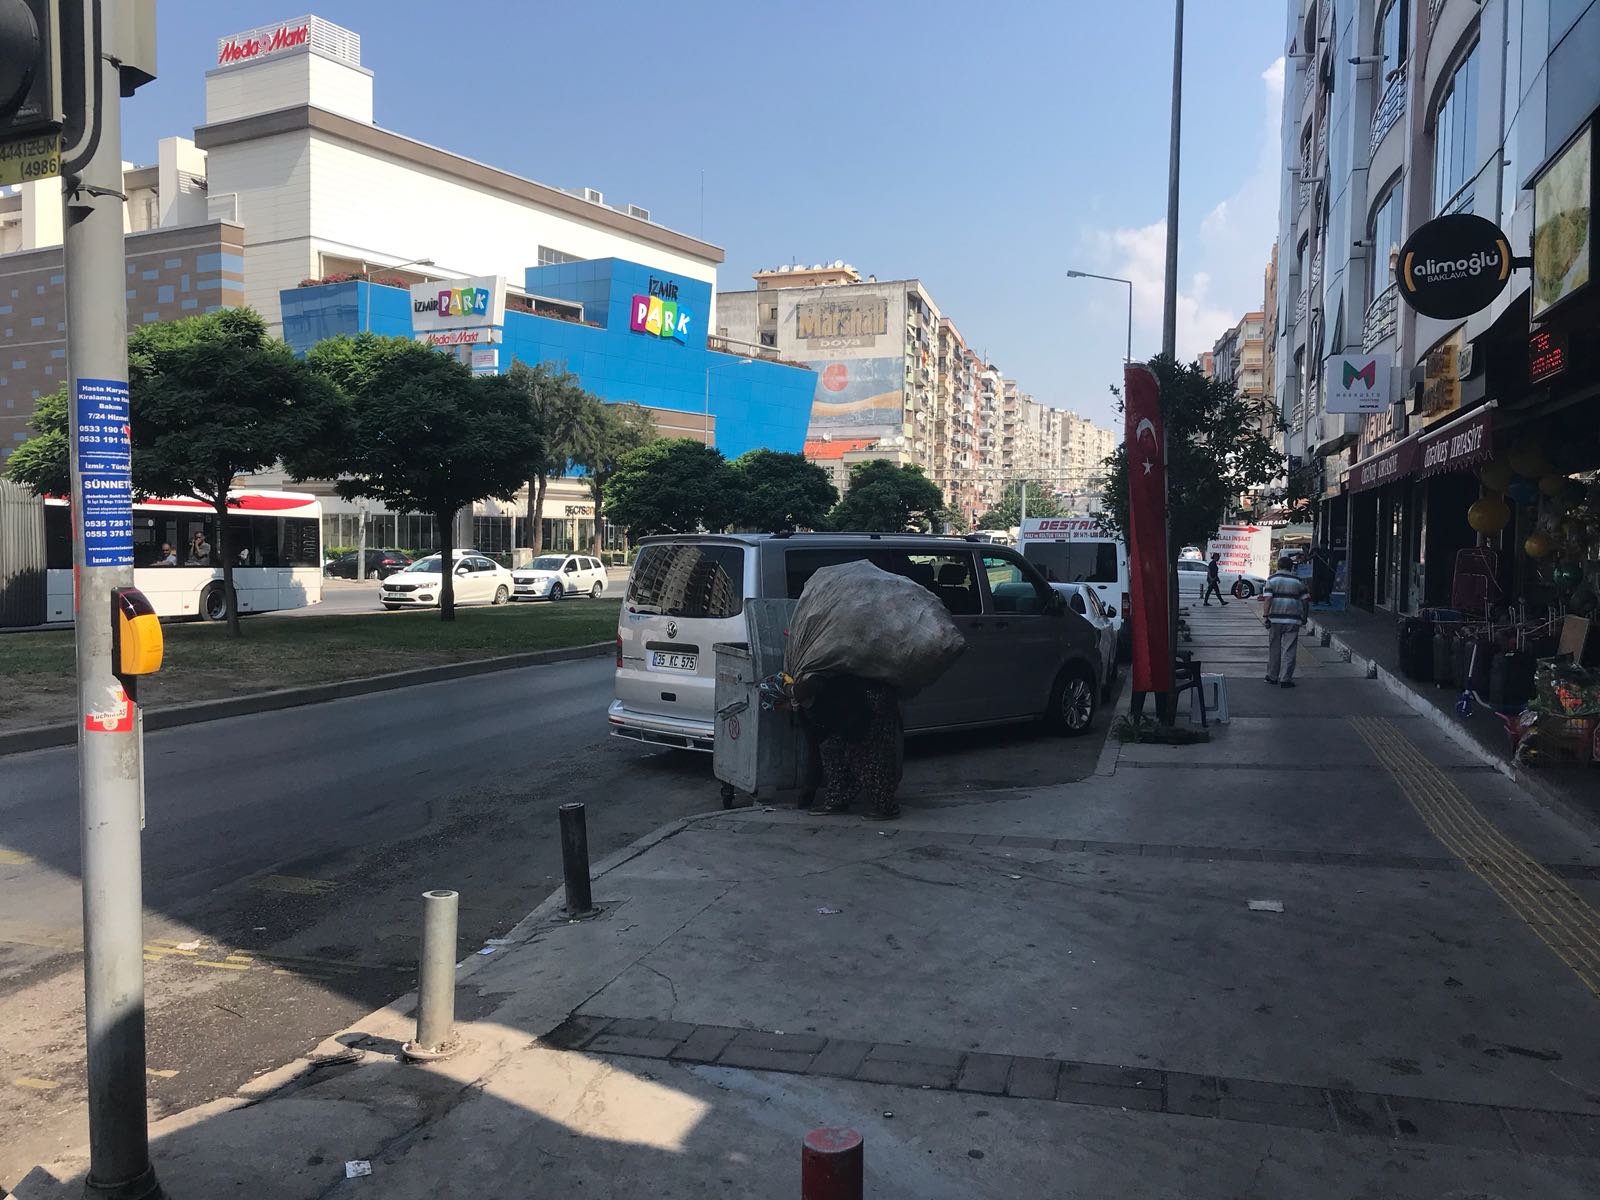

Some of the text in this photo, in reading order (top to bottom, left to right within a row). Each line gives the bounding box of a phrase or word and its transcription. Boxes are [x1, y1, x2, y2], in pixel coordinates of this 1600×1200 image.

[218, 24, 308, 64] Media Markt
[1427, 271, 1468, 282] BAKLAVA
[648, 275, 679, 300] İZMİR
[414, 291, 487, 314] İZMİR PARK
[635, 299, 691, 338] PARK
[456, 331, 479, 343] Markt
[85, 461, 105, 469] İzmir
[657, 654, 695, 668] 35 KC 575
